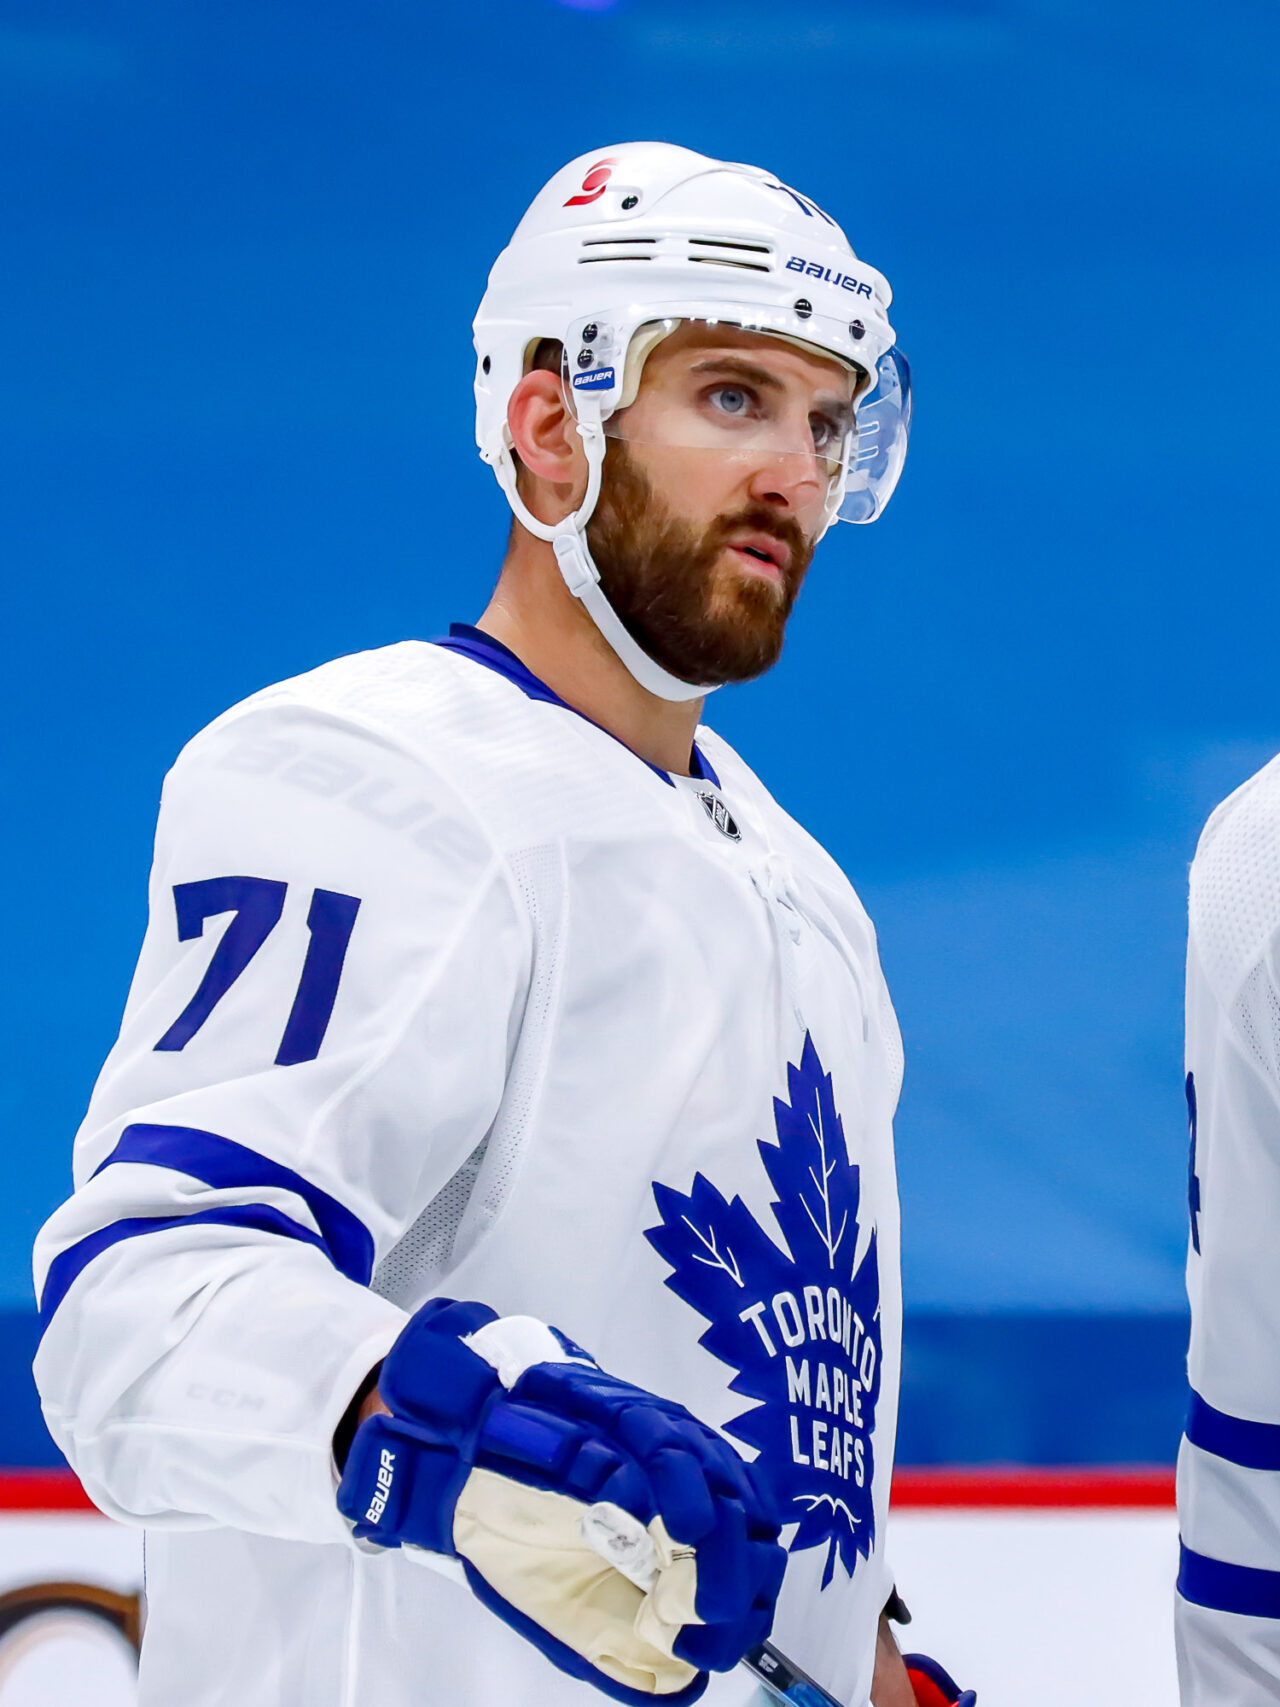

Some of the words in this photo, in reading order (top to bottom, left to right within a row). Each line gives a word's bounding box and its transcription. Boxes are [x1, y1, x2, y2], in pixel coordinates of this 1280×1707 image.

[785, 256, 873, 300] BAUER
[574, 371, 613, 386] BAUER
[152, 876, 361, 1066] 71
[739, 1285, 876, 1392] TORONTO
[785, 1356, 864, 1428] MAPLE
[365, 1449, 396, 1524] BAUER
[790, 1415, 864, 1488] LEAFS
